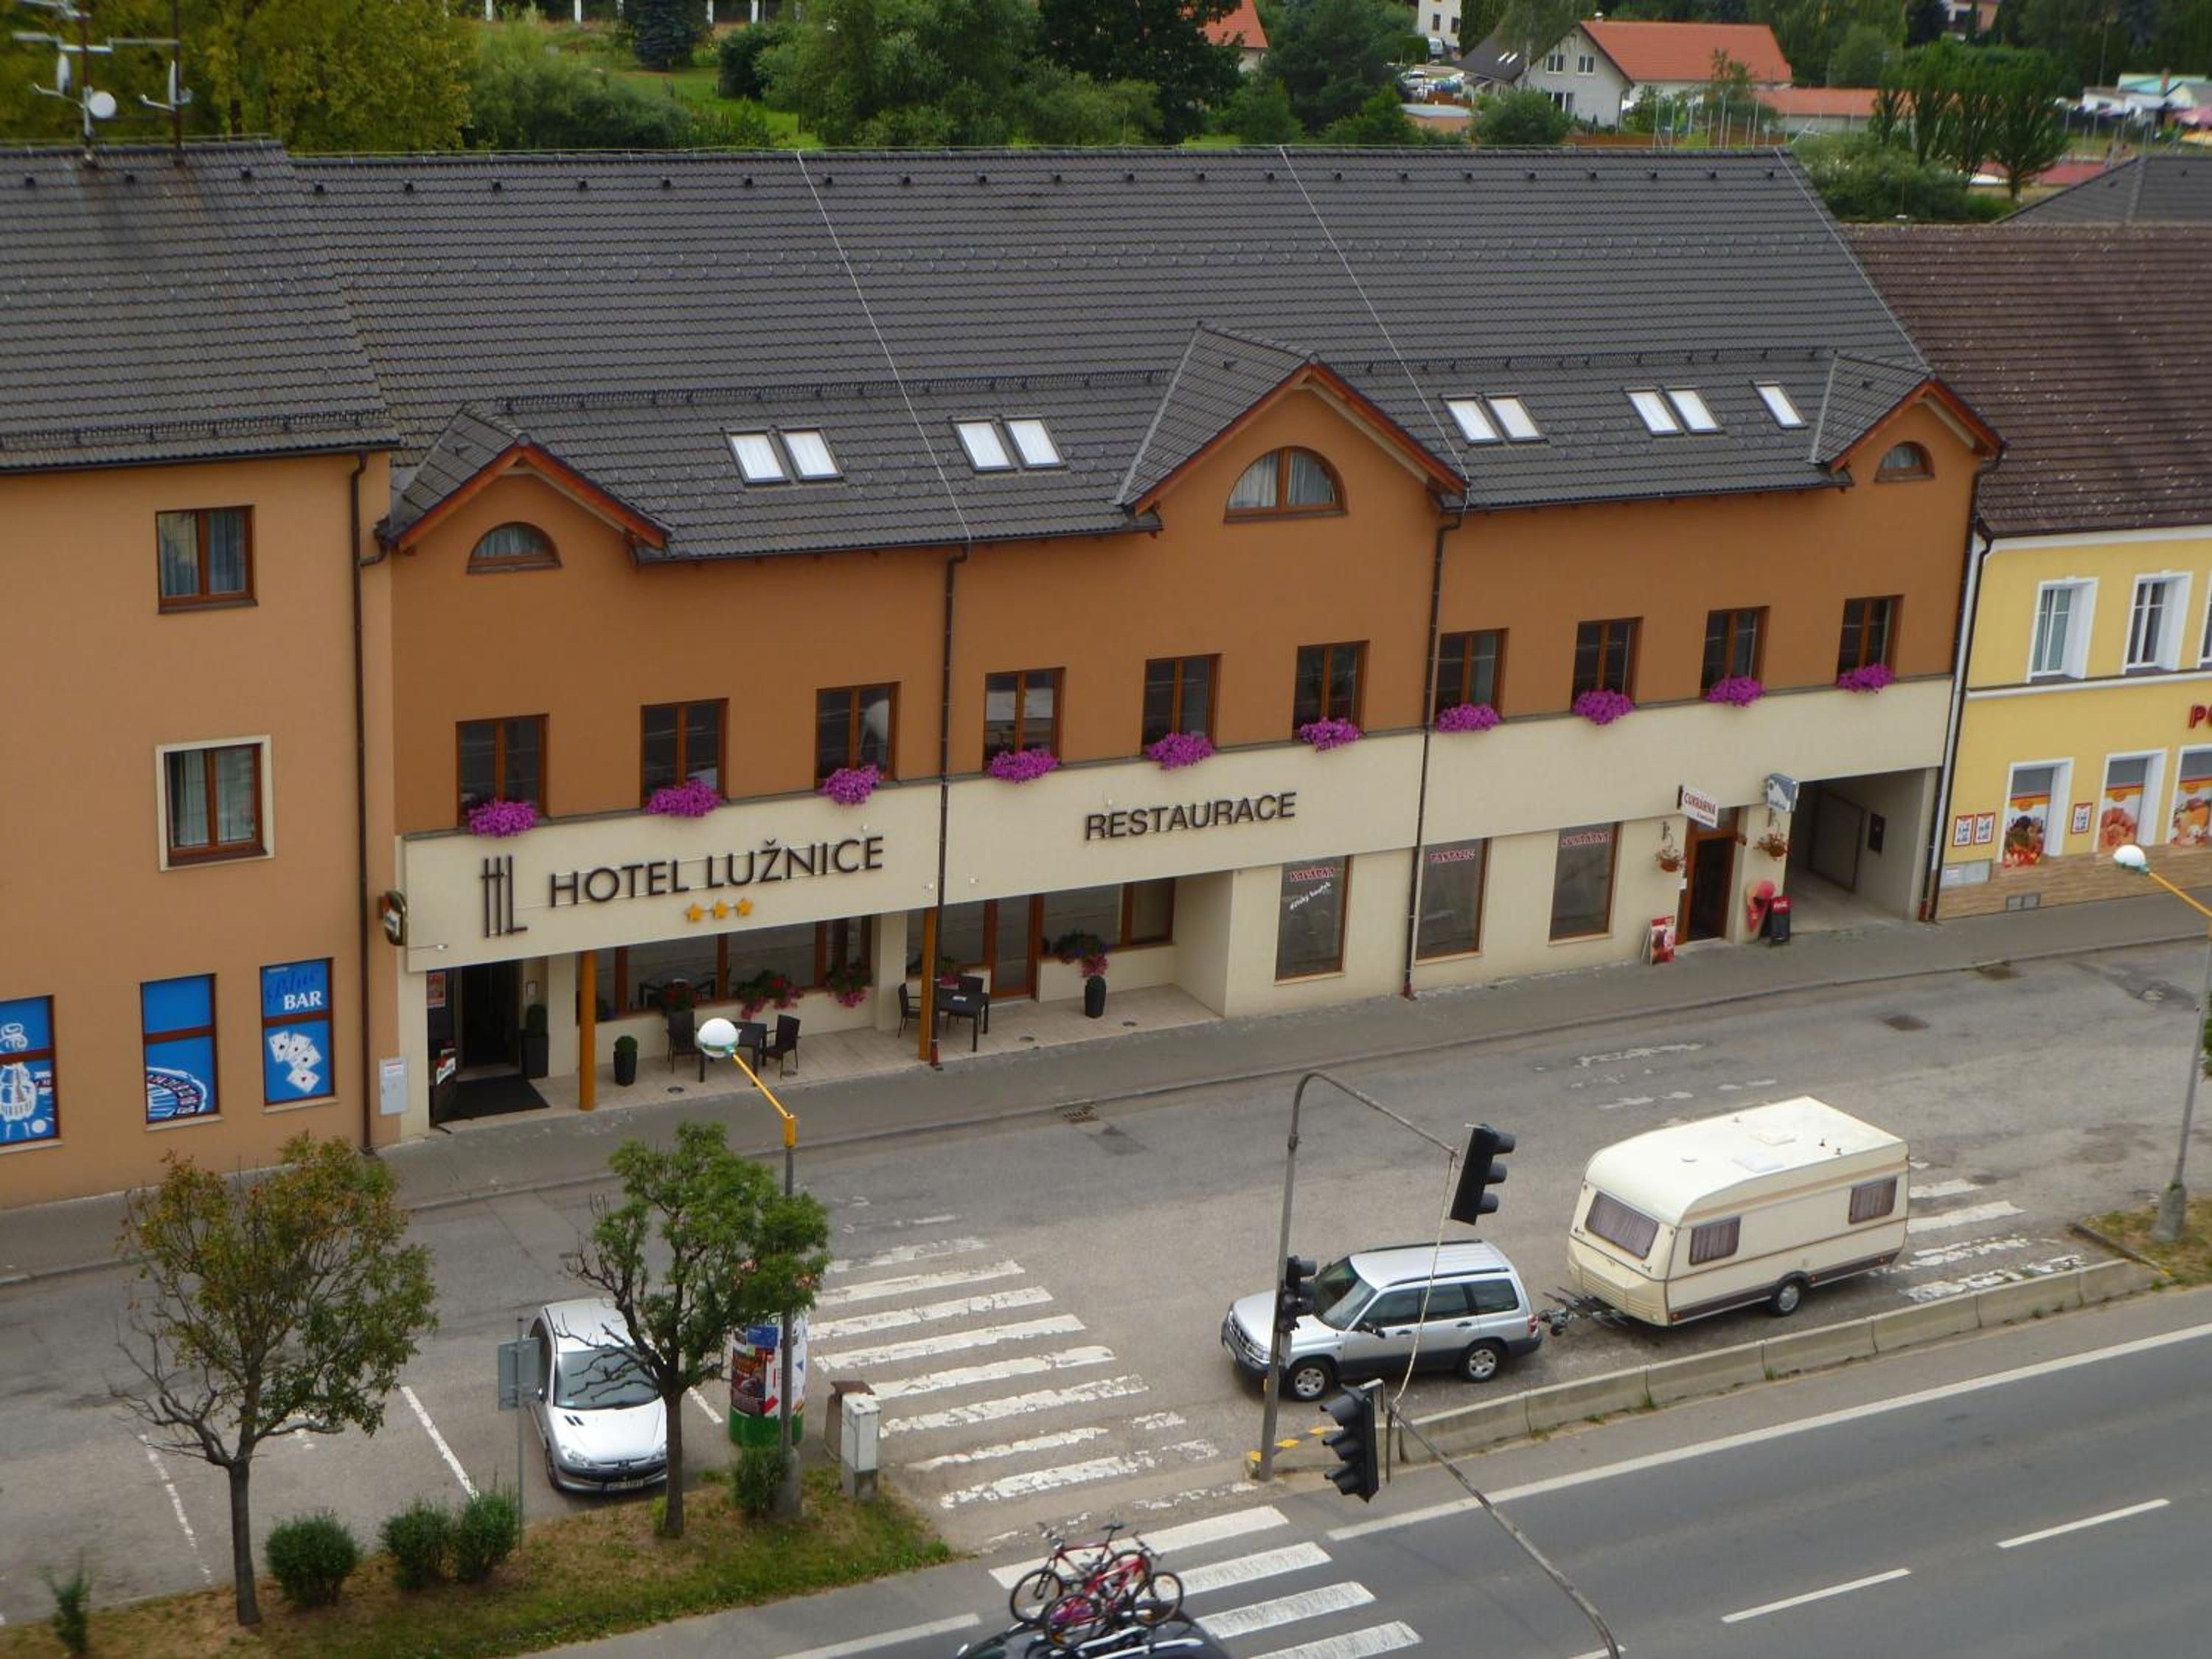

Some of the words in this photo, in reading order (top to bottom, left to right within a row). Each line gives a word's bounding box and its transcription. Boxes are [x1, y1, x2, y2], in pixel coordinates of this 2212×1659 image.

[1085, 791, 1298, 841] RESTAURACE
[551, 859, 689, 908] HOTEL
[706, 835, 884, 889] LUŽNICE
[283, 990, 323, 1011] BAR
